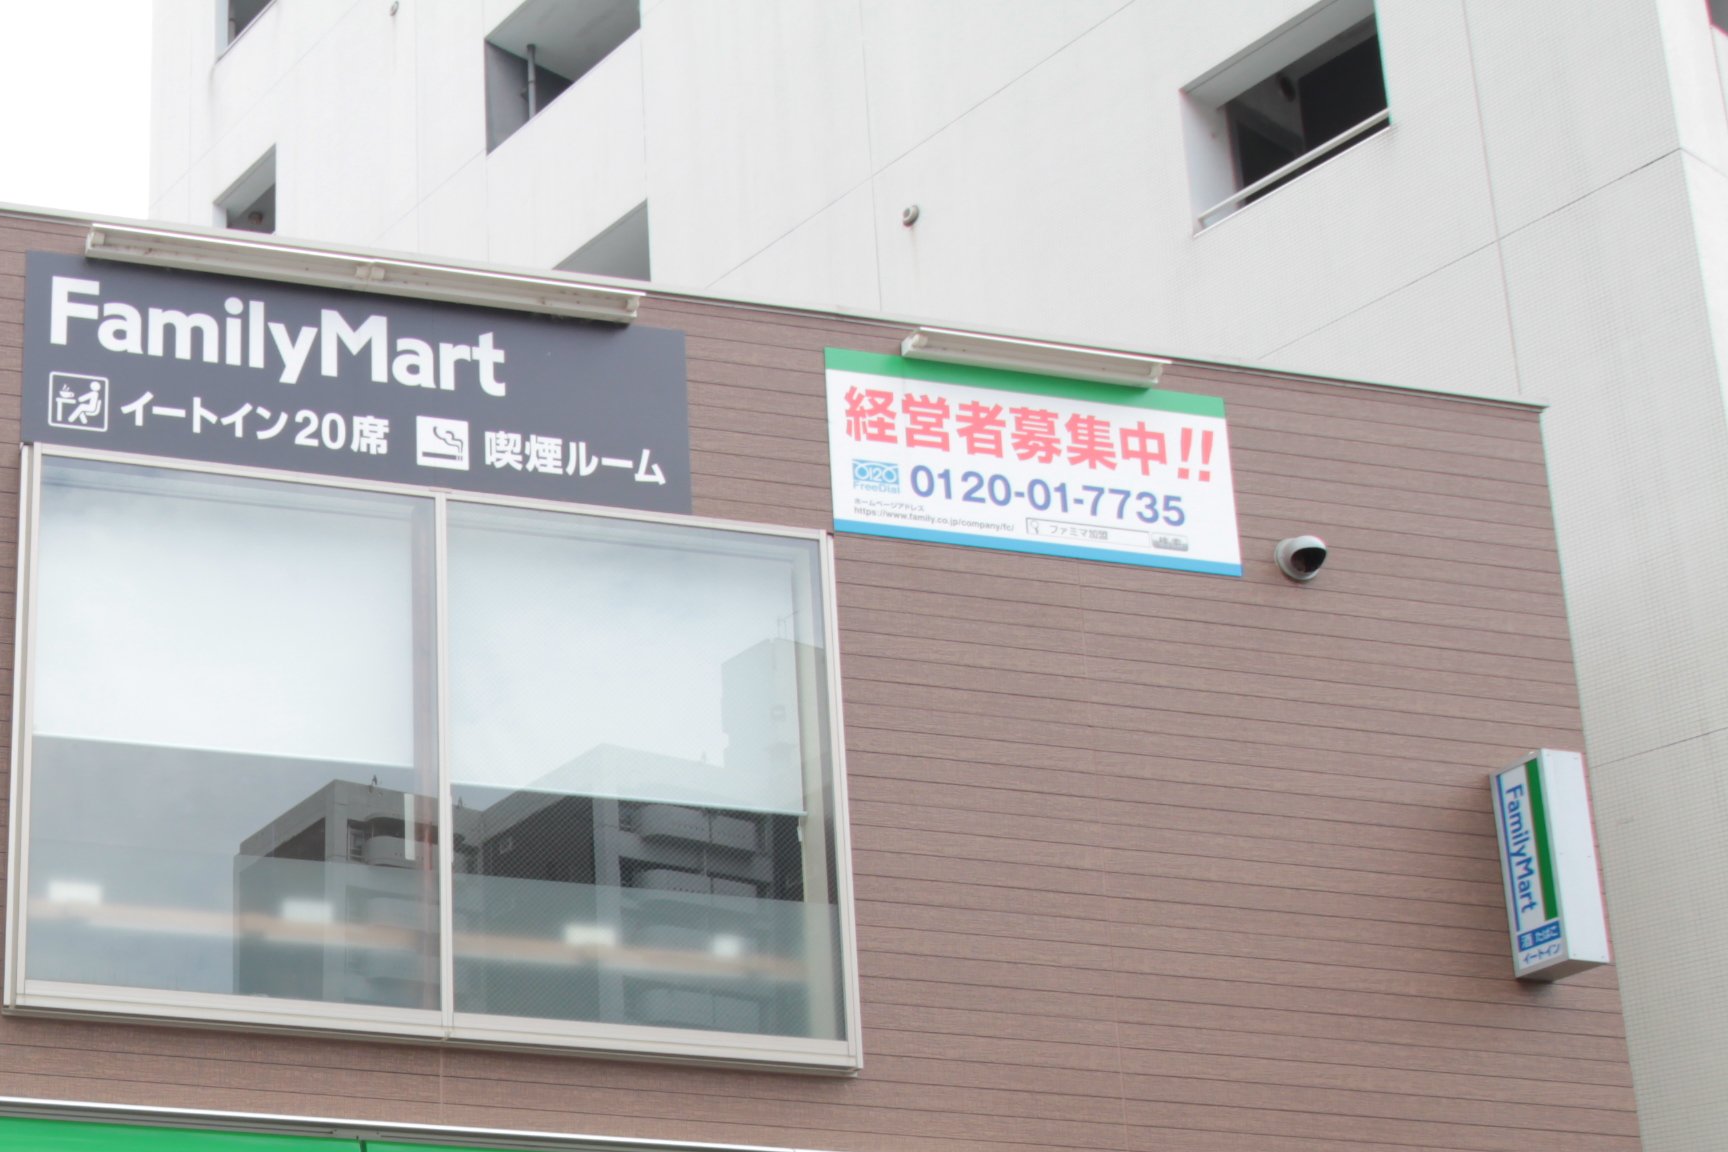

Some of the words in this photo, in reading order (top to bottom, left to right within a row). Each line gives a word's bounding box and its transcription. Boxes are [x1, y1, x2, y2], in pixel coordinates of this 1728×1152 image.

[49, 275, 506, 397] FamilyMart
[120, 390, 391, 456] イートイン20席
[484, 429, 667, 486] 喫煙ルーム
[844, 385, 1215, 482] 経営者募集中!!
[910, 464, 1186, 528] 0120-01-7735
[1503, 783, 1539, 914] FamilyMart
